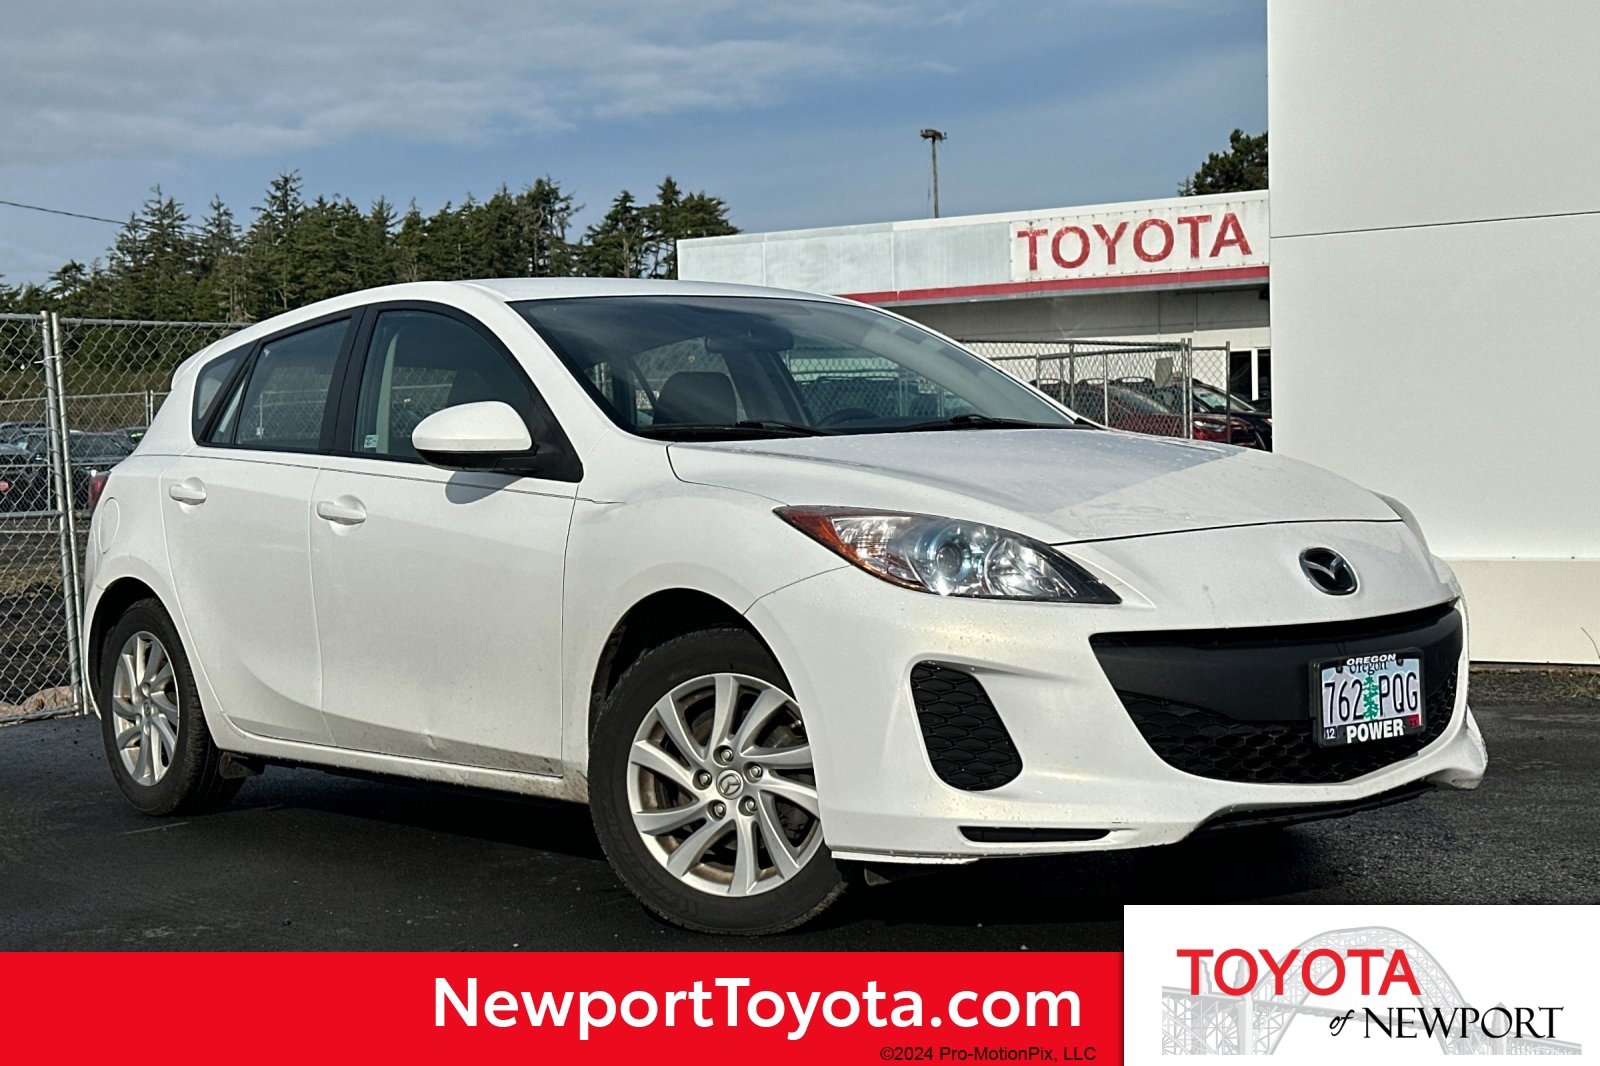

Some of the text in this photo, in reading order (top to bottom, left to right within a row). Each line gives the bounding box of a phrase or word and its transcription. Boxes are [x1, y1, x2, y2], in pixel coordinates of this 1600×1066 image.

[1017, 212, 1252, 270] TOYOTA
[1346, 653, 1396, 666] OREGON
[1324, 672, 1418, 724] 762 PQG
[1325, 728, 1336, 740] 12
[1346, 719, 1404, 744] POWER
